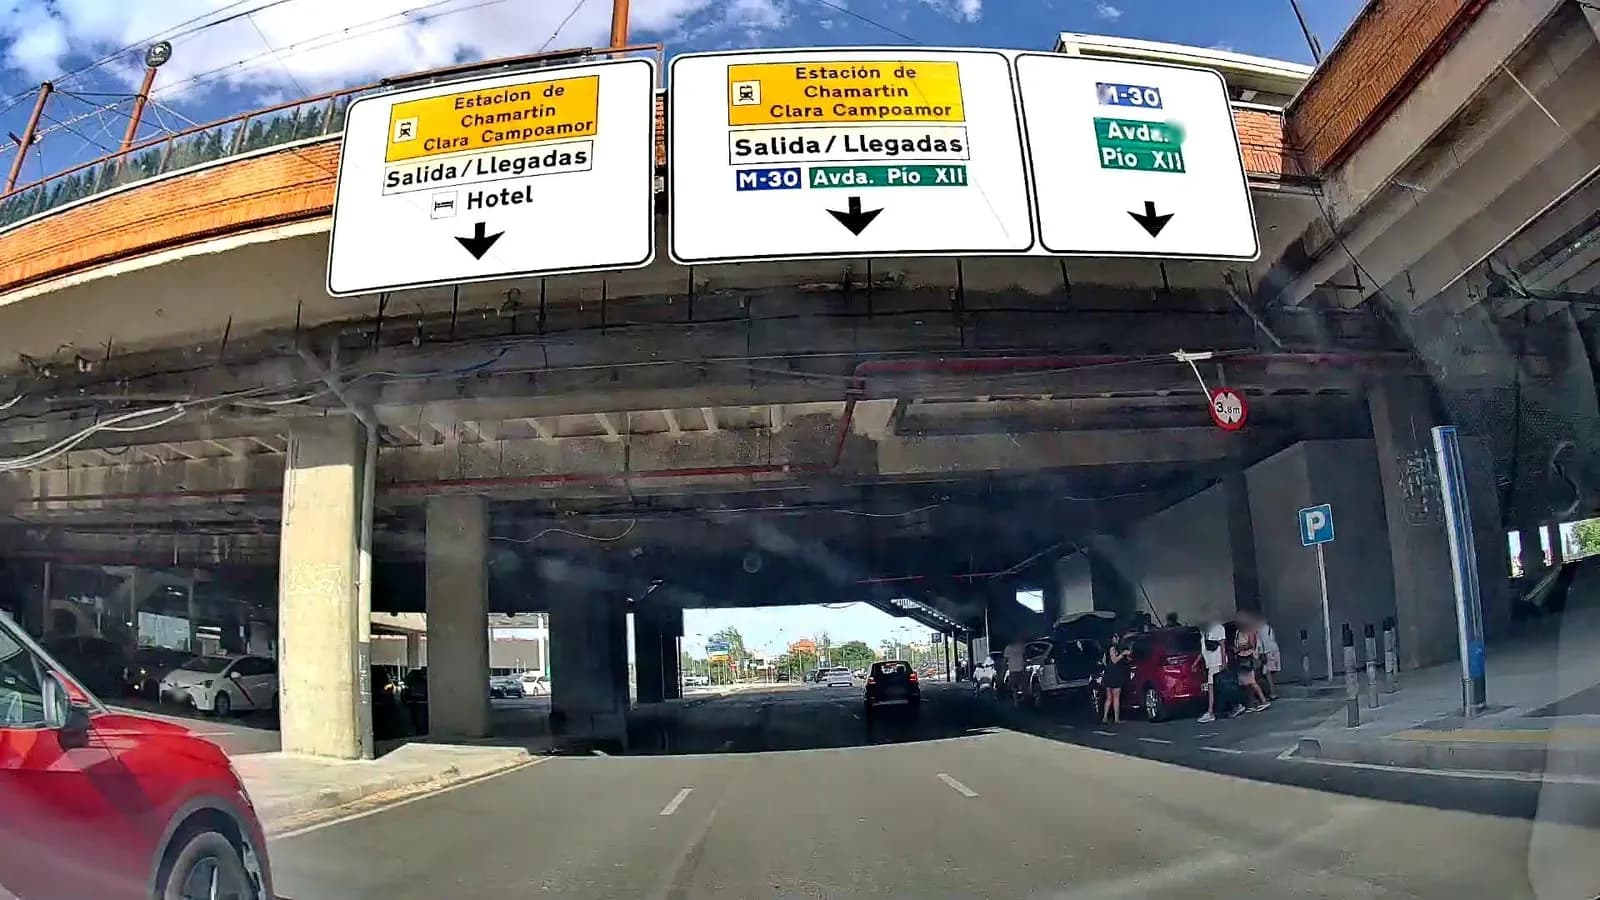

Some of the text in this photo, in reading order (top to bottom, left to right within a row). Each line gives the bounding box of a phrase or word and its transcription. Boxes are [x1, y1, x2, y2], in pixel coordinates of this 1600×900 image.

[795, 65, 917, 79] Estación de
[543, 84, 565, 97] de
[770, 103, 952, 118] Clara Campoamor
[423, 120, 593, 152] Clara Campoamor
[1107, 120, 1169, 143] Avda.
[1101, 147, 1182, 170] Pío XII
[739, 170, 799, 189] M-30
[813, 167, 964, 186] Avda. Pío XII
[467, 186, 533, 210] Hotel
[1306, 511, 1326, 540] P
